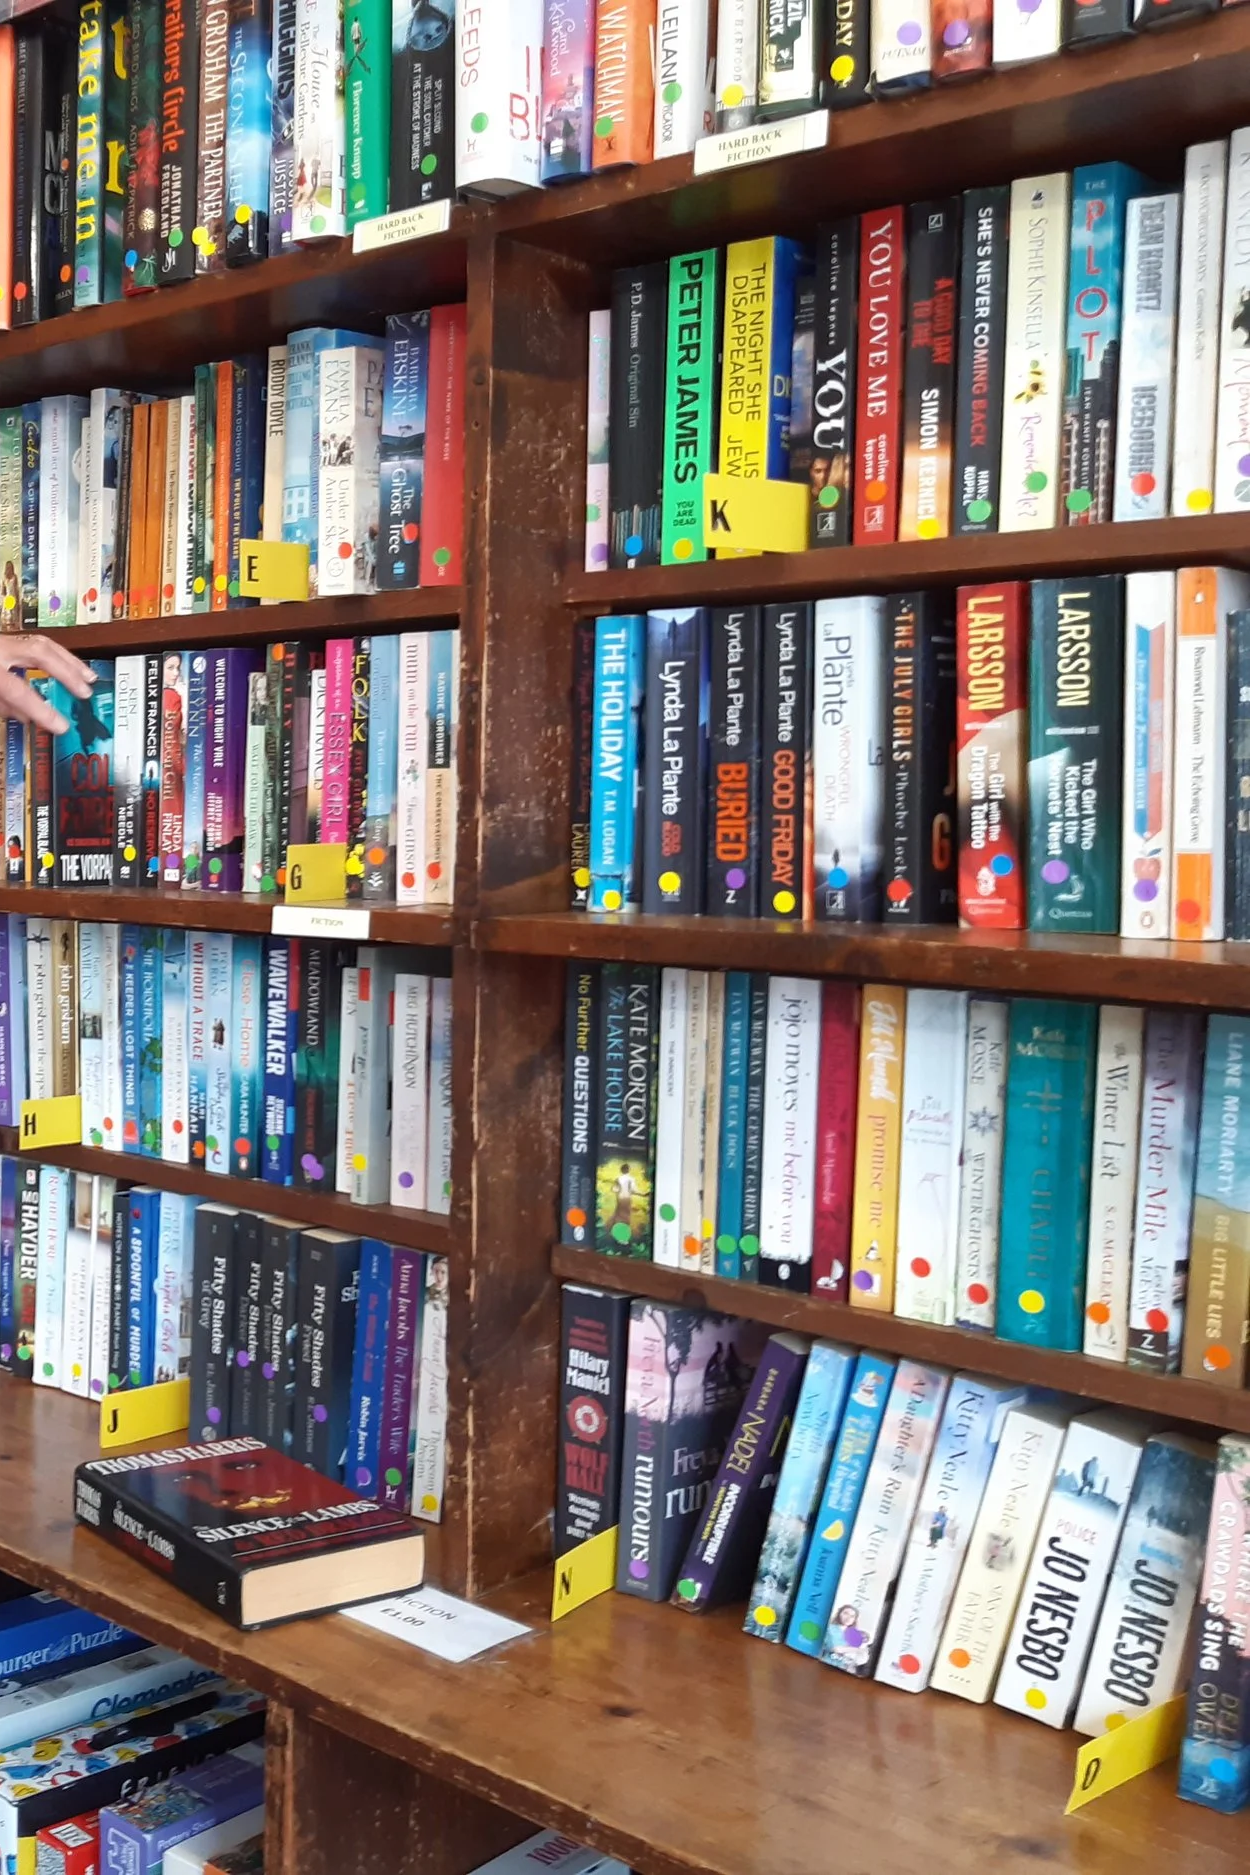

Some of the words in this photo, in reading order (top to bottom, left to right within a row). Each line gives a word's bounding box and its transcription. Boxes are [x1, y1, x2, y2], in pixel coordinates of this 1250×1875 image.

[78, 1, 104, 97] take
[204, 9, 228, 103] GRISHAM
[298, 22, 310, 80] Bellevue
[596, 6, 627, 123] WATCHMAN
[661, 4, 679, 84] LEILANI
[310, 46, 329, 109] House
[433, 79, 442, 101] SPLIT
[162, 86, 186, 153] Circle
[205, 109, 224, 146] THE
[297, 83, 309, 140] Gardens
[351, 81, 363, 134] Florence
[433, 103, 442, 134] SECOND
[78, 113, 101, 180] me
[351, 138, 362, 179] Knapp
[718, 137, 748, 152] HARD
[751, 128, 782, 145] BACK
[726, 144, 771, 163] FICTION
[160, 165, 171, 238] FREEDLAND
[202, 148, 223, 223] PARTNER
[274, 159, 286, 215] JUSTICE
[75, 191, 100, 244] in
[377, 219, 400, 232] HARD
[402, 212, 424, 225] BACK
[383, 225, 417, 241] FICTION
[976, 207, 992, 256] SHE'S
[868, 219, 892, 288] YOU
[630, 282, 642, 307] P.D.
[750, 263, 766, 303] THE
[975, 260, 991, 319] NEVER
[630, 309, 641, 348] James
[677, 257, 703, 365] PETER
[868, 295, 889, 368] LOVE
[728, 276, 748, 415] DISAPPEARED
[747, 311, 765, 376] NIGHT
[972, 323, 989, 395] COMING
[270, 359, 285, 397] RODDY
[629, 354, 640, 404] Original
[813, 348, 846, 449] YOU
[867, 376, 887, 418] ME
[270, 401, 285, 437] DOYLE
[629, 407, 640, 428] Sin
[746, 383, 761, 422] SHE
[920, 389, 940, 449] SIMON
[970, 400, 986, 447] BACK
[674, 375, 701, 484] JAMES
[390, 468, 403, 516] Ghost
[402, 486, 414, 509] The
[710, 499, 732, 533] K
[389, 523, 402, 554] Tree
[247, 555, 260, 583] E
[602, 629, 626, 676] THE
[775, 612, 797, 661] Lynda
[966, 595, 1005, 710] LARSSON
[1056, 591, 1091, 707] LARSSON
[148, 660, 158, 697] FELIX
[214, 658, 226, 701] WELCOME
[658, 661, 686, 722] Lynda
[779, 665, 796, 687] La
[147, 701, 157, 756] FRANCIS
[214, 704, 224, 714] TO
[214, 718, 224, 745] NIGHT
[599, 681, 624, 781] HOLIDAY
[777, 691, 795, 742] Plante
[212, 746, 223, 767] VALE
[663, 727, 683, 756] La
[661, 760, 682, 816] Plante
[773, 749, 796, 809] GOOD
[968, 745, 989, 800] Dragon
[603, 789, 617, 816] T.M.
[716, 762, 748, 862] BURIED
[970, 804, 988, 849] Tattoo
[162, 812, 172, 853] FINLAY
[171, 815, 181, 852] LINDA
[602, 820, 616, 865] LOGAN
[771, 814, 793, 886] FRIDAY
[291, 864, 302, 890] G
[307, 949, 320, 1046] MEADOWLAND
[578, 974, 591, 994] No
[266, 949, 288, 1076] WAVEWALKER
[576, 997, 591, 1051] Further
[627, 984, 649, 1037] KATE
[779, 995, 807, 1038] jojo
[606, 1014, 625, 1061] LAKE
[604, 1068, 624, 1132] HOUSE
[623, 1042, 647, 1140] MORTON
[779, 1044, 801, 1112] moyes
[24, 1112, 36, 1136] H
[572, 1055, 590, 1154] QUESTIONS
[1145, 1076, 1175, 1177] Murder
[1142, 1185, 1169, 1242] Mile
[20, 1205, 38, 1279] HAYDER
[201, 1280, 210, 1293] of
[210, 1256, 226, 1295] Fifty
[398, 1259, 413, 1293] Anna
[199, 1296, 211, 1329] Grey
[211, 1298, 224, 1354] Shades
[394, 1297, 412, 1340] Jacobs
[105, 1408, 121, 1434] J
[725, 1411, 767, 1477] NADEL
[85, 1448, 187, 1476] THOMAS
[183, 1436, 268, 1460] HARRIS
[196, 1515, 292, 1543] SILENCE
[309, 1499, 380, 1527] LAMBS
[630, 1454, 655, 1561] rumours
[1041, 1535, 1090, 1580] JO
[556, 1566, 573, 1600] N
[1131, 1560, 1179, 1605] JO
[70, 1623, 124, 1654] Puzzle
[379, 1607, 426, 1627] £1.00
[1016, 1580, 1082, 1682] NESBO
[1104, 1604, 1170, 1706] NESBO
